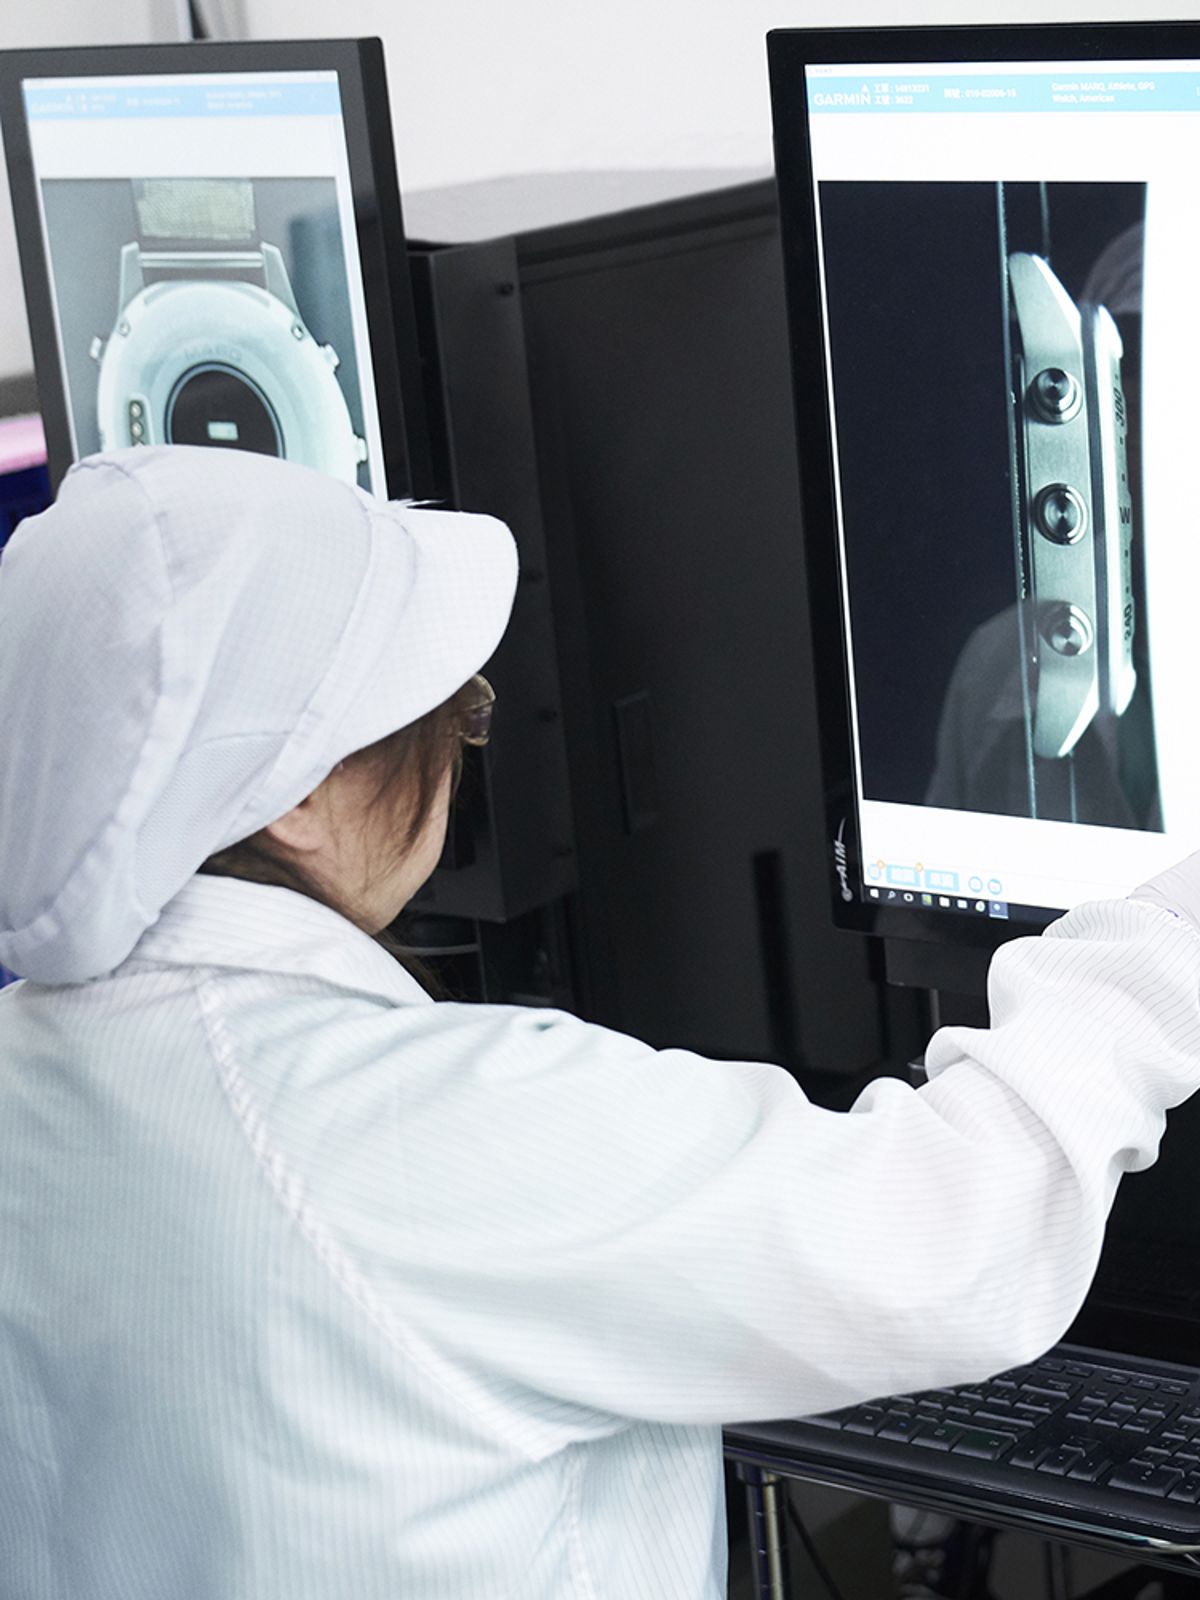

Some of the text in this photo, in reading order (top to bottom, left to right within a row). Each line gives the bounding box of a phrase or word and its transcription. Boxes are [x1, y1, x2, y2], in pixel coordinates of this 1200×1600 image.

[1137, 81, 1155, 90] GPS
[813, 93, 871, 105] GARMIN
[1119, 506, 1130, 524] W
